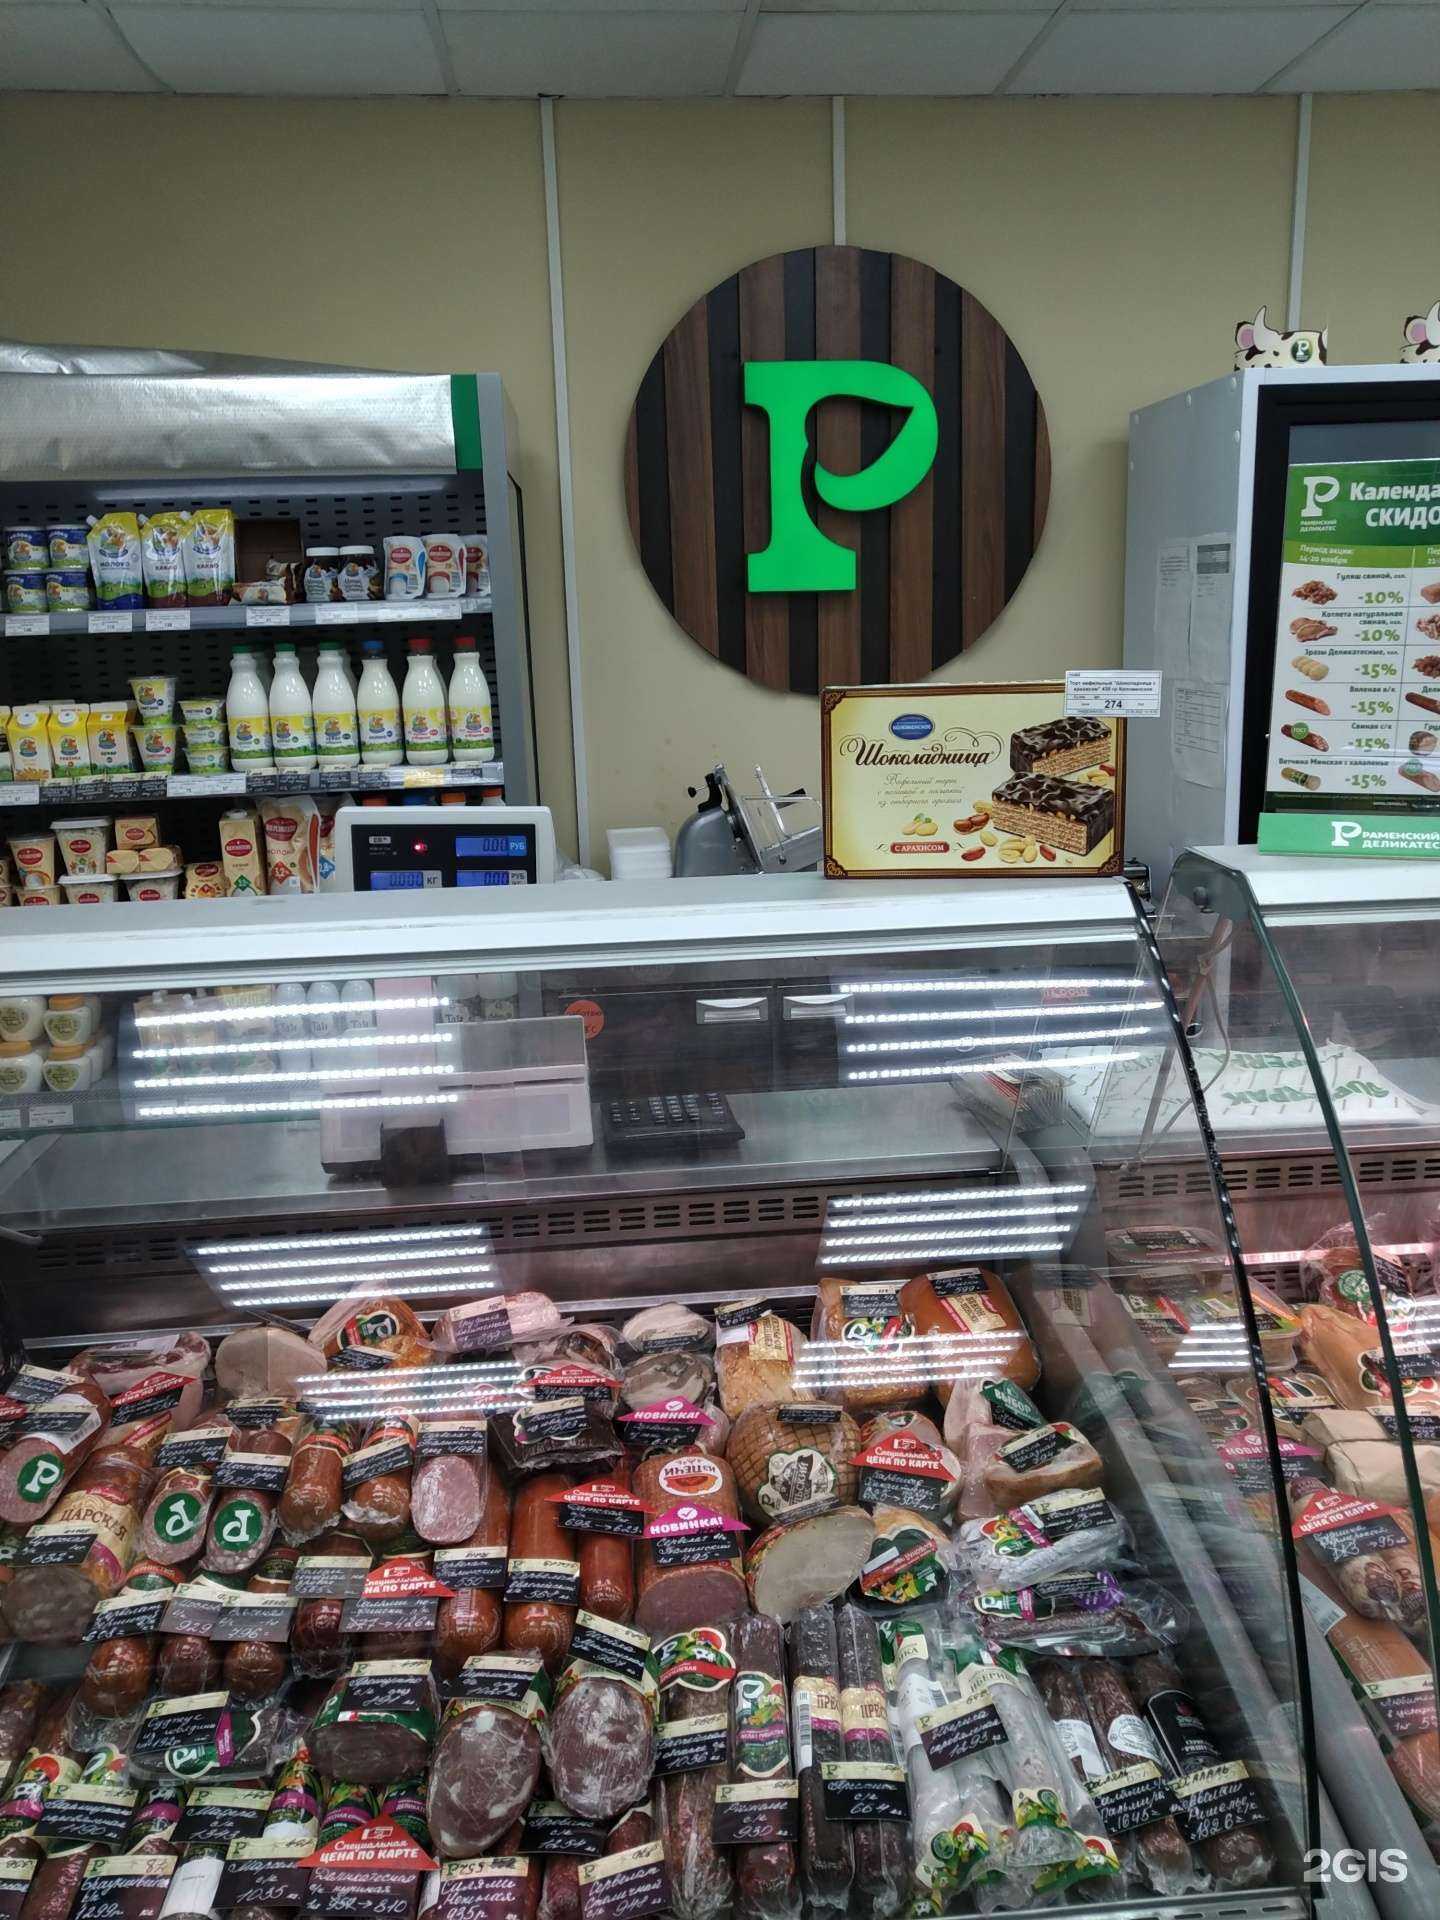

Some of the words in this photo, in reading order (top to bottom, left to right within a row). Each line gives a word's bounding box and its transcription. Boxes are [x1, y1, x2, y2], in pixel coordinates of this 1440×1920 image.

[744, 360, 938, 593] Р
[1358, 591, 1404, 604] -10%
[1354, 629, 1400, 642] -10%
[1354, 663, 1397, 679] -15%
[1104, 700, 1123, 709] 274
[1351, 700, 1394, 716] -15%
[843, 737, 991, 767] Шоколадница
[1345, 774, 1387, 789] -15%
[1363, 831, 1440, 840] РАМЕНСКИЙ
[901, 844, 945, 852] АРАХИСОМ
[1362, 840, 1440, 849] ДЕЛИКАТЕС
[634, 1411, 700, 1420] НОВИНКА!
[866, 1456, 892, 1465] ЦЕНА
[894, 1458, 907, 1467] ПО
[909, 1461, 939, 1470] КАРТЕ
[564, 1494, 590, 1503] ЦЕНА
[593, 1495, 606, 1504] ПО
[608, 1496, 641, 1506] КАРТЕ
[1300, 1519, 1331, 1532] ЦЕНА
[1331, 1513, 1344, 1522] ПО
[1344, 1502, 1380, 1519] КАРТЕ
[60, 1508, 128, 1540] ЦАРСКАЯ
[650, 1516, 724, 1535] НОВИНКА!
[367, 1577, 426, 1586] пециальная
[386, 1585, 399, 1593] ПО
[401, 1581, 436, 1590] КАРТЕ
[335, 1840, 408, 1851] Специальная
[320, 1850, 354, 1864] ЦЕНА
[360, 1849, 375, 1860] ПО
[377, 1847, 420, 1860] КАРТЕ
